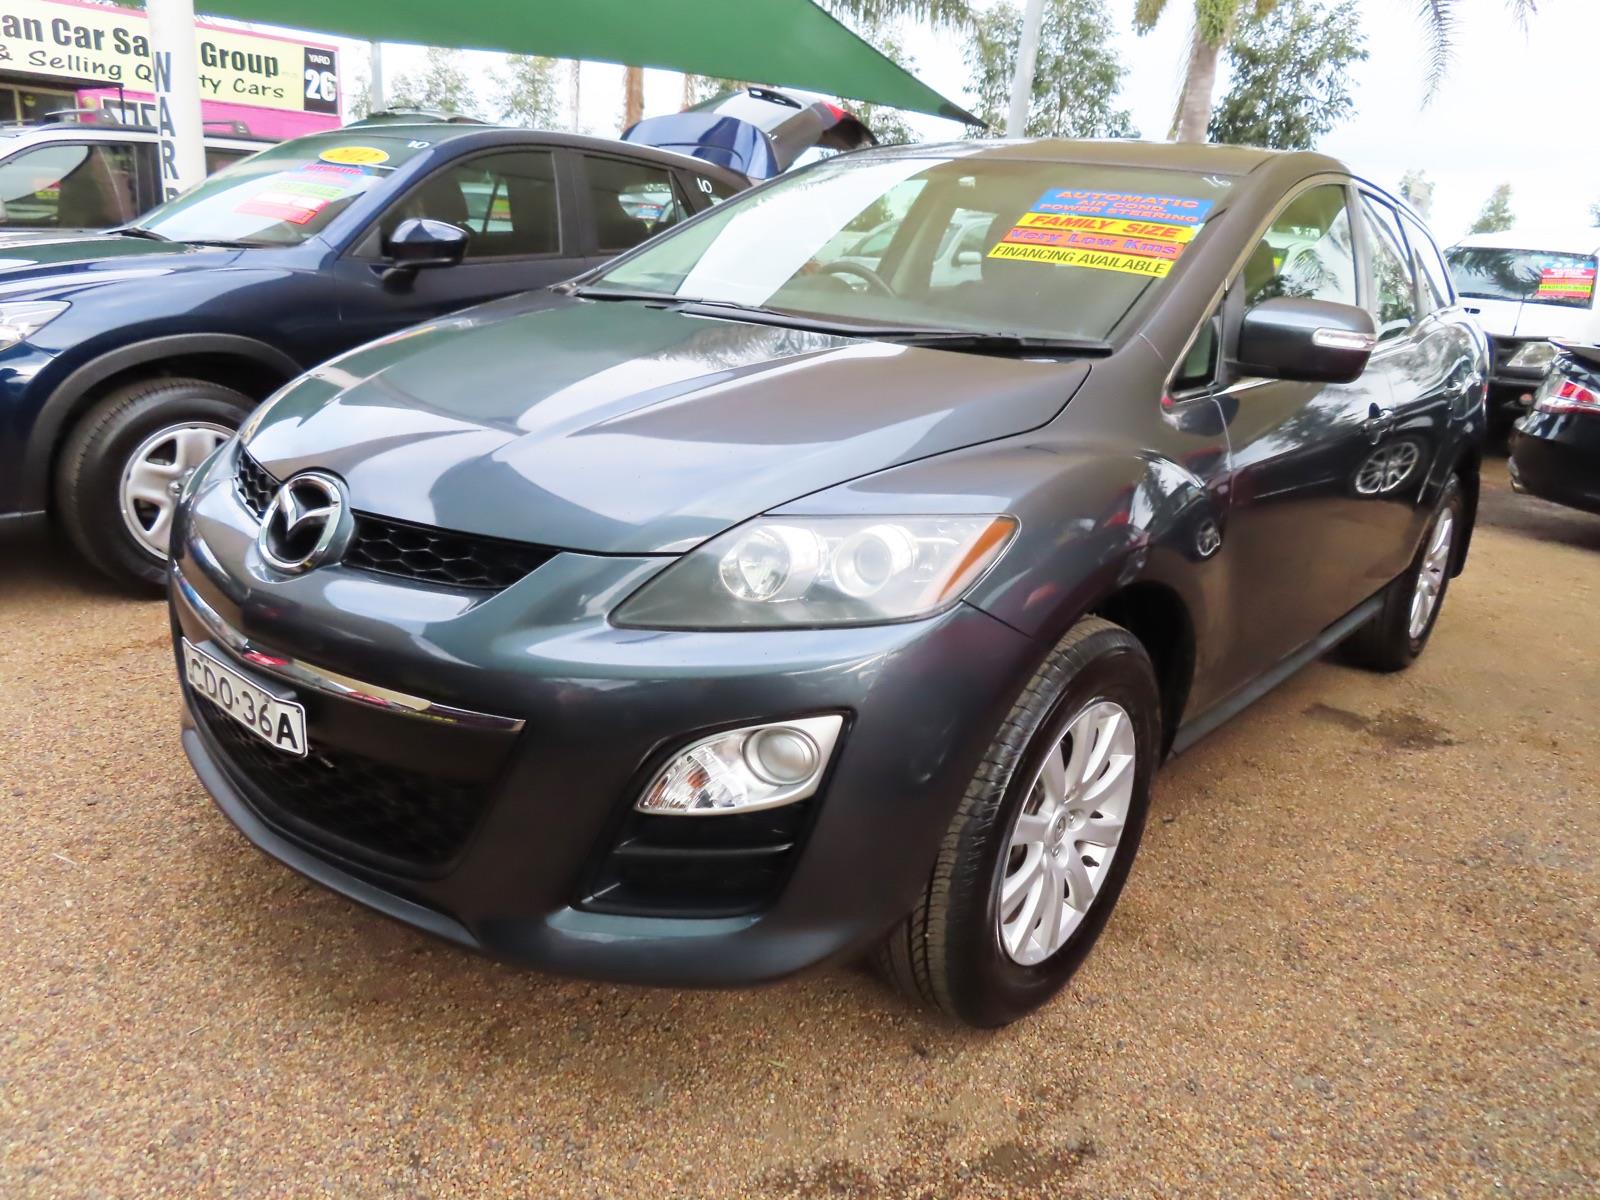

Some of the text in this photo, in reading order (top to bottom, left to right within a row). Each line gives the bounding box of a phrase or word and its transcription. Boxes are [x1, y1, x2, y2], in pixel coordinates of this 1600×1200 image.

[51, 18, 104, 50] Car
[200, 41, 279, 78] Group
[28, 50, 122, 80] Selling
[308, 54, 331, 66] YARD
[233, 78, 285, 99] Cars
[1055, 190, 1200, 209] AUTOMATIC
[1039, 203, 1199, 222] POWER STEERING
[1028, 215, 1184, 238] FAMILY SIZE
[1011, 229, 1177, 255] Very Low Kms
[992, 246, 1168, 274] FINANCING AVAILABLE
